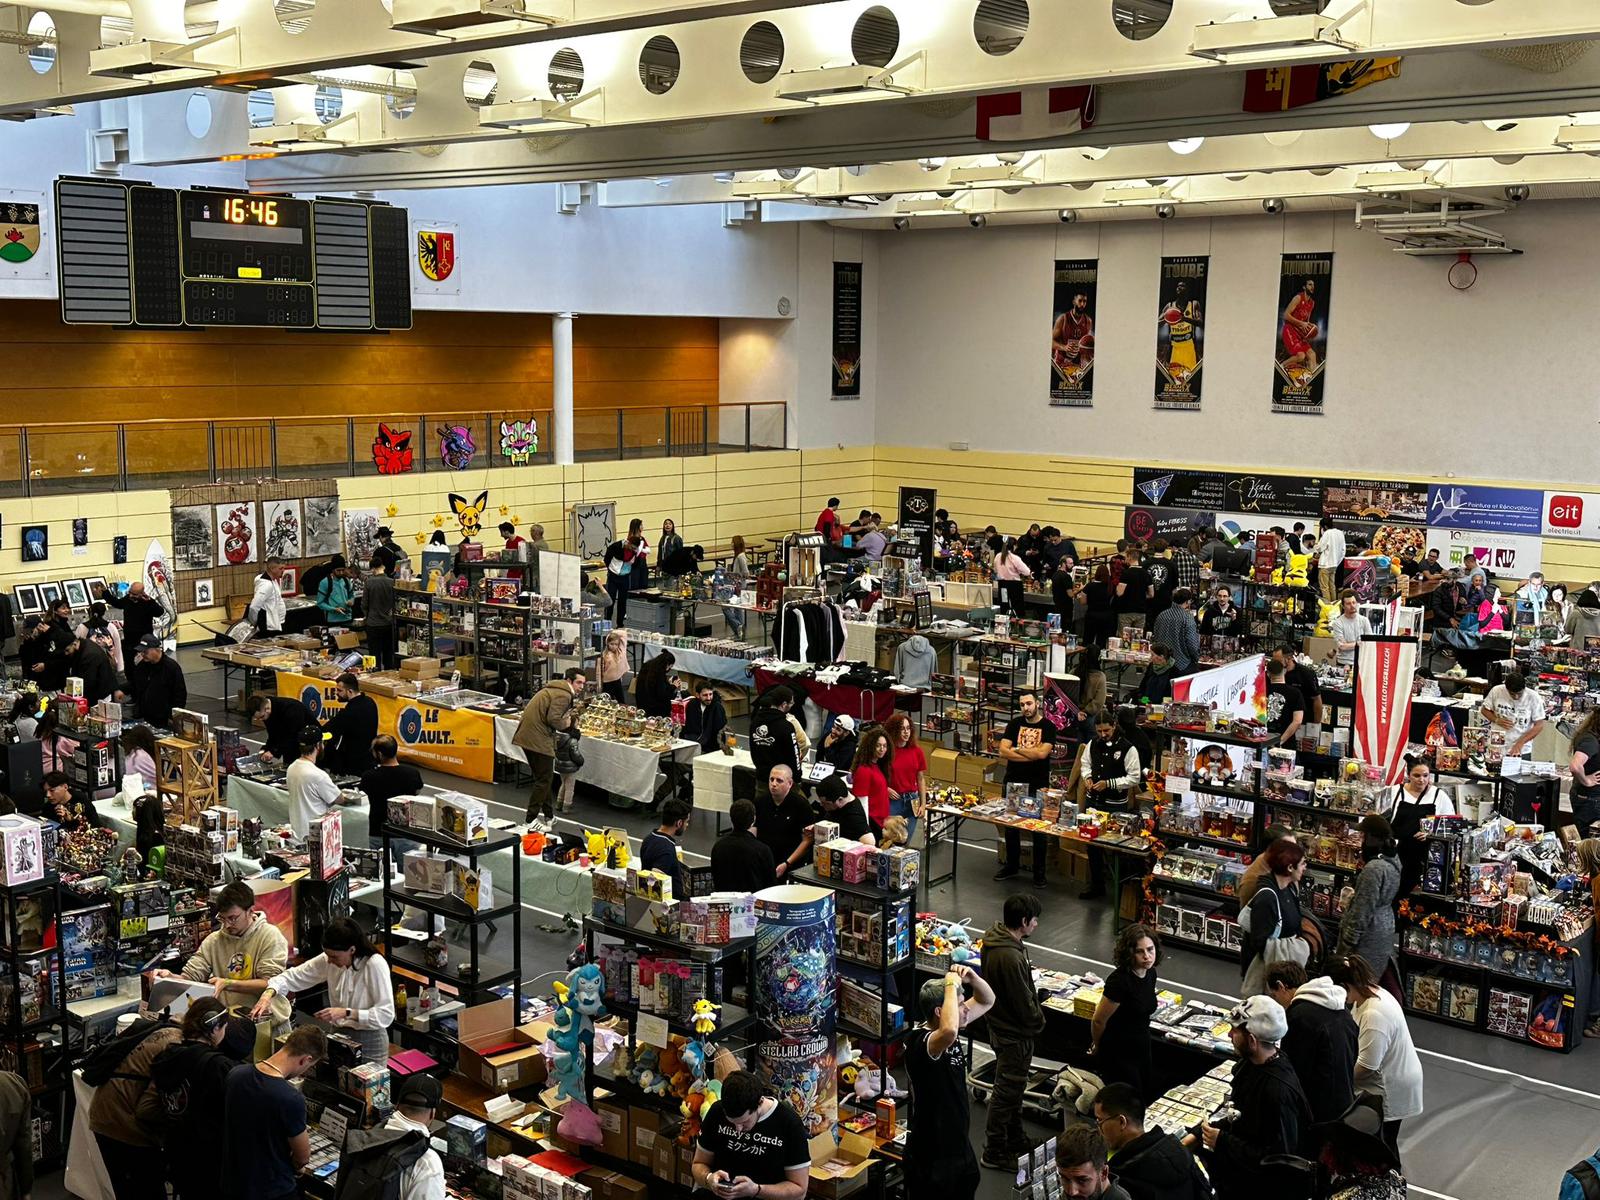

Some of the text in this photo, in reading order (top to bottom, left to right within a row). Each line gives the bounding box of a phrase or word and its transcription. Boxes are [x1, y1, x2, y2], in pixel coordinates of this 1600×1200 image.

[224, 198, 278, 225] 16:46
[1467, 501, 1491, 509] Peinture
[1552, 505, 1579, 519] eit
[425, 709, 439, 723] LE
[760, 1044, 799, 1058] STELLAR
[800, 1039, 828, 1056] CROWN
[727, 1139, 767, 1155] ミクシカド
[752, 1132, 783, 1147] Cards
